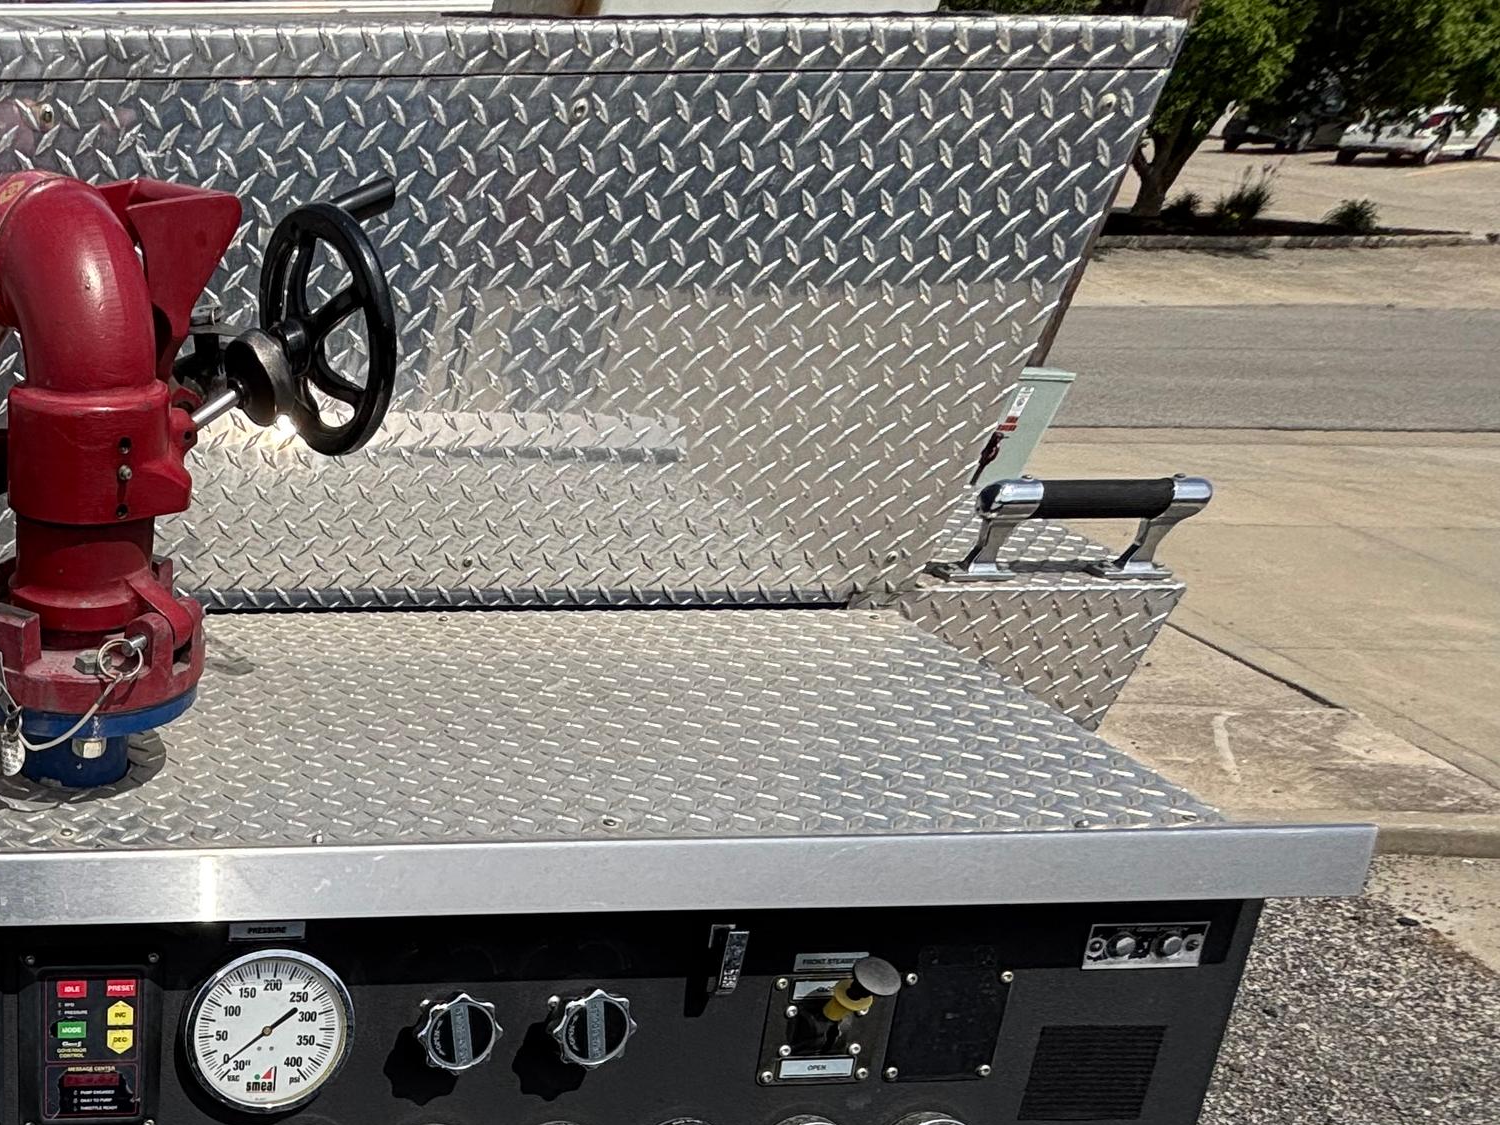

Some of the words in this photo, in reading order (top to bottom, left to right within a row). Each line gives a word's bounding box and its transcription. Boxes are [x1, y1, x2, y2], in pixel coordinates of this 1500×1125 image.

[107, 984, 135, 992] PRESET
[263, 979, 282, 992] 200
[238, 987, 257, 998] 150
[289, 991, 309, 1003] 250
[223, 1005, 241, 1017] 100
[298, 1011, 317, 1022] 300
[215, 1030, 228, 1041] 50
[296, 1035, 315, 1046] 350
[223, 1053, 230, 1064] 0
[284, 1056, 302, 1067] 400
[246, 1066, 277, 1092] smeal
[288, 1076, 301, 1085] psi
